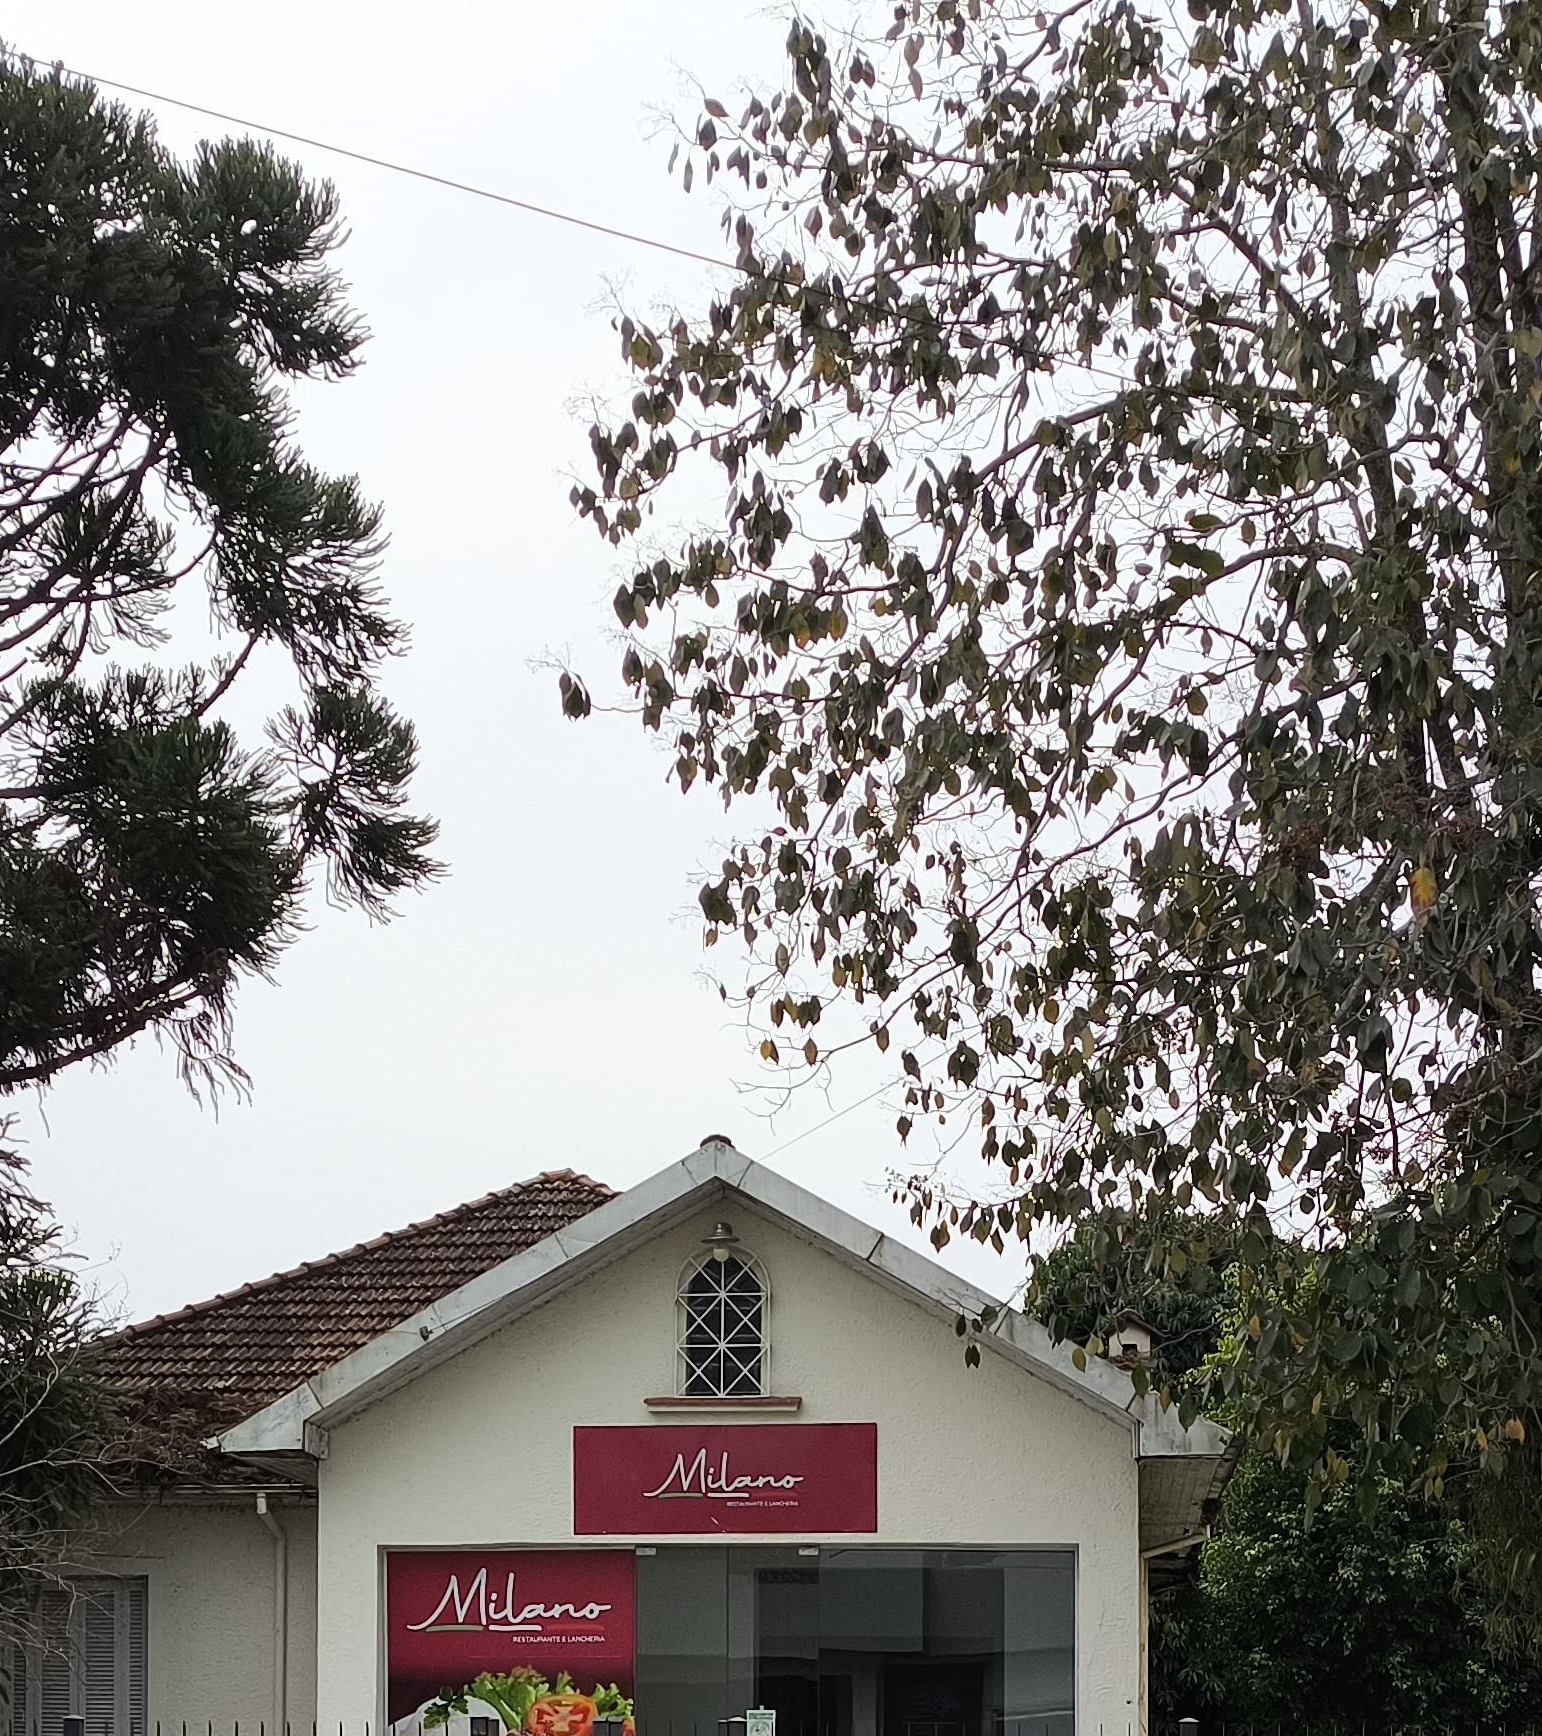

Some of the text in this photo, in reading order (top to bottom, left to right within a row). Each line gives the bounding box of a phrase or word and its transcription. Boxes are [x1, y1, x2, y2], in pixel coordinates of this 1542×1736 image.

[643, 1448, 804, 1497] Milano
[407, 1568, 611, 1630] Milano
[512, 1635, 561, 1643] RESTAURANTE
[567, 1635, 605, 1643] LANCHERIA
